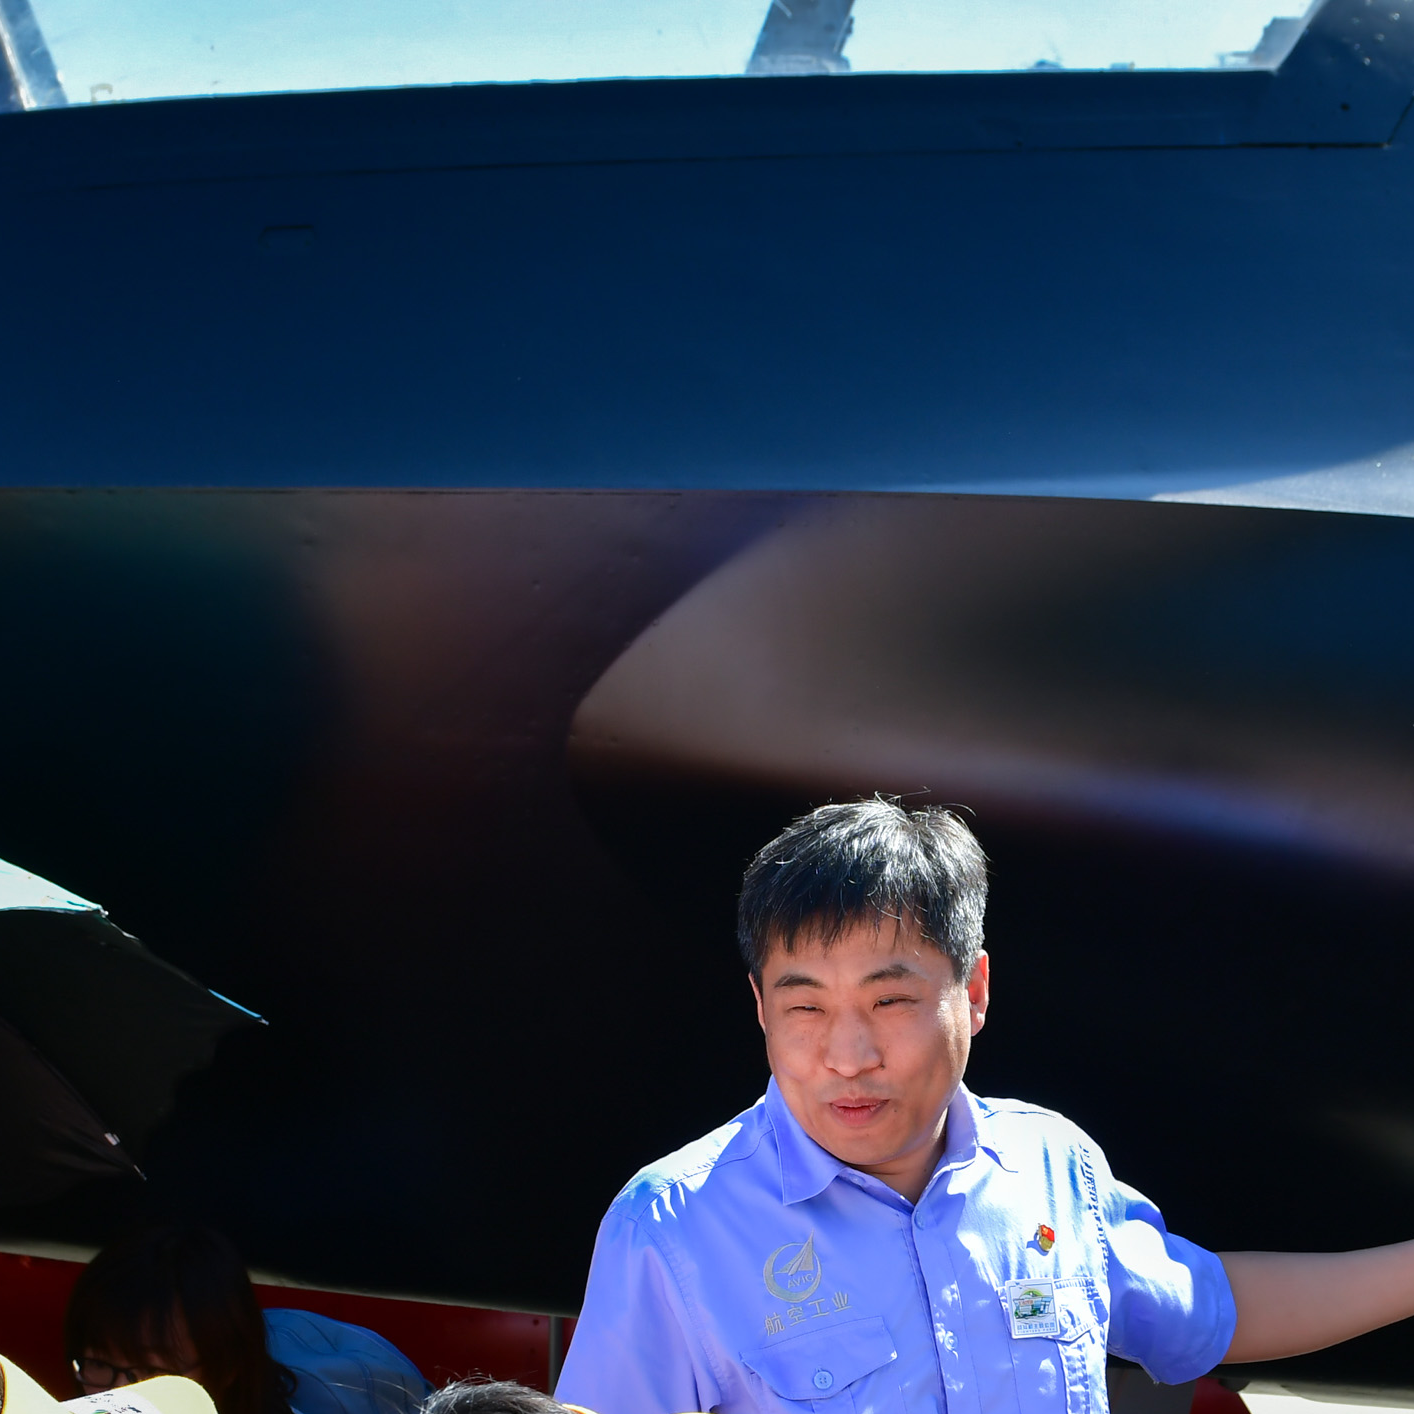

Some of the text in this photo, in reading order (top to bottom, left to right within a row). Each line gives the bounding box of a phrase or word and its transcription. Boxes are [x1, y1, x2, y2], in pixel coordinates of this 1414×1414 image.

[787, 1273, 814, 1289] AVIC
[764, 1291, 853, 1337] 航空工业
